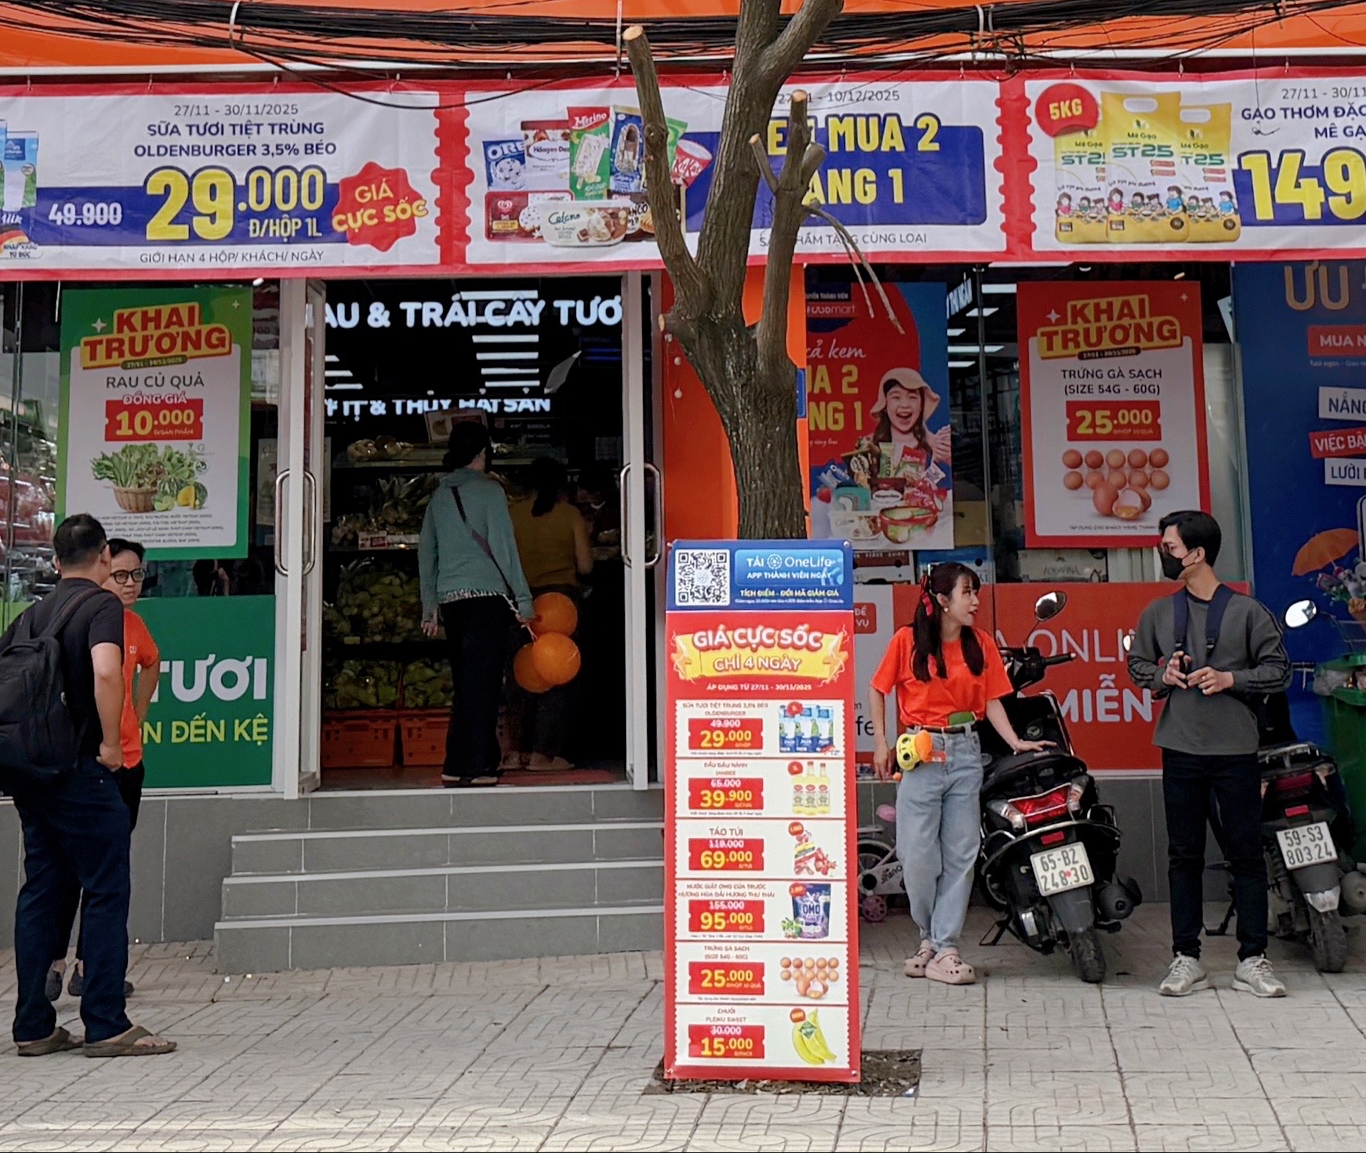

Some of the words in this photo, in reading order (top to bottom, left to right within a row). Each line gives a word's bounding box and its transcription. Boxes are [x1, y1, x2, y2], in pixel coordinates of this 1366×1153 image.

[827, 89, 900, 103] 10/12/2025
[1281, 87, 1319, 100] 27/11
[173, 104, 210, 117] 27/11
[224, 103, 299, 117] 30/11/2025
[572, 110, 608, 129] Merino
[1048, 98, 1084, 121] 5KG
[1241, 106, 1276, 124] GẠO
[1280, 105, 1330, 120] THƠM
[146, 121, 182, 137] SỮA
[185, 122, 226, 137] TƯƠI
[229, 120, 265, 139] TIỆT
[267, 120, 325, 137] TRÙNG
[827, 114, 906, 153] MUA
[916, 114, 941, 152] 2
[1314, 122, 1339, 139] MÊ
[134, 142, 257, 158] OLDENBURGER
[261, 142, 300, 158] 3,5%
[303, 138, 337, 156] BÉO
[1112, 143, 1174, 159] ST25
[354, 178, 394, 205] GIÁ
[887, 167, 905, 205] 1
[144, 166, 326, 242] 29.000
[48, 202, 123, 227] 49.900
[332, 209, 378, 235] CỰC
[383, 196, 430, 225] SỐC
[306, 217, 323, 238] 1L
[862, 230, 897, 245] CÙNG
[899, 232, 928, 247] LOẠI
[139, 249, 167, 264] GIỚI
[168, 251, 195, 267] HẠN
[199, 251, 206, 263] 4
[291, 247, 325, 263] NGÀY
[1284, 259, 1350, 311] ƯU
[116, 303, 197, 335] KHAI
[367, 301, 391, 327] &
[399, 293, 477, 328] TRÁI
[484, 291, 546, 327] CÂY
[1070, 299, 1147, 326] KHAI
[82, 326, 227, 363] TRƯƠNG
[1040, 318, 1179, 353] TRƯƠNG
[1319, 334, 1354, 347] MUA
[106, 375, 139, 389] RAU
[144, 371, 165, 388] CỦ
[170, 372, 205, 389] QUẢ
[841, 364, 859, 395] 2
[1061, 365, 1104, 379] TRỨNG
[1107, 364, 1126, 379] GÀ
[1129, 368, 1163, 383] SẠCH
[164, 391, 188, 405] GIÁ
[1064, 384, 1095, 396] (SIZE
[1098, 384, 1121, 395] 54G
[1133, 383, 1161, 396] 60G)
[115, 408, 196, 437] 10.000
[853, 400, 863, 432] 1
[1075, 408, 1153, 436] 25.000
[1315, 433, 1346, 453] VIỆC
[1330, 464, 1361, 481] LƯỜI
[784, 554, 833, 568] OneLife
[693, 624, 730, 648] GIÁ
[734, 624, 776, 650] CỰC
[779, 623, 823, 648] SỐC
[744, 656, 754, 668] 4
[756, 654, 802, 671] NGÀY
[1056, 673, 1154, 724] MIỄN
[170, 711, 226, 744] ĐẾN
[234, 711, 269, 746] KỆ
[710, 719, 742, 728] 49.900
[700, 729, 752, 748] 29.000
[700, 789, 752, 808] 39.900
[709, 826, 728, 836] TÁO
[1283, 825, 1325, 848] 59-S3
[700, 850, 753, 869] 69.000
[1039, 846, 1080, 873] 65-B2
[1285, 842, 1334, 867] 803.24
[1040, 864, 1090, 894] 248.30
[802, 904, 821, 916] OMO
[700, 911, 754, 930] 95.000
[700, 968, 754, 988] 25.000
[700, 1037, 754, 1057] 15.000
